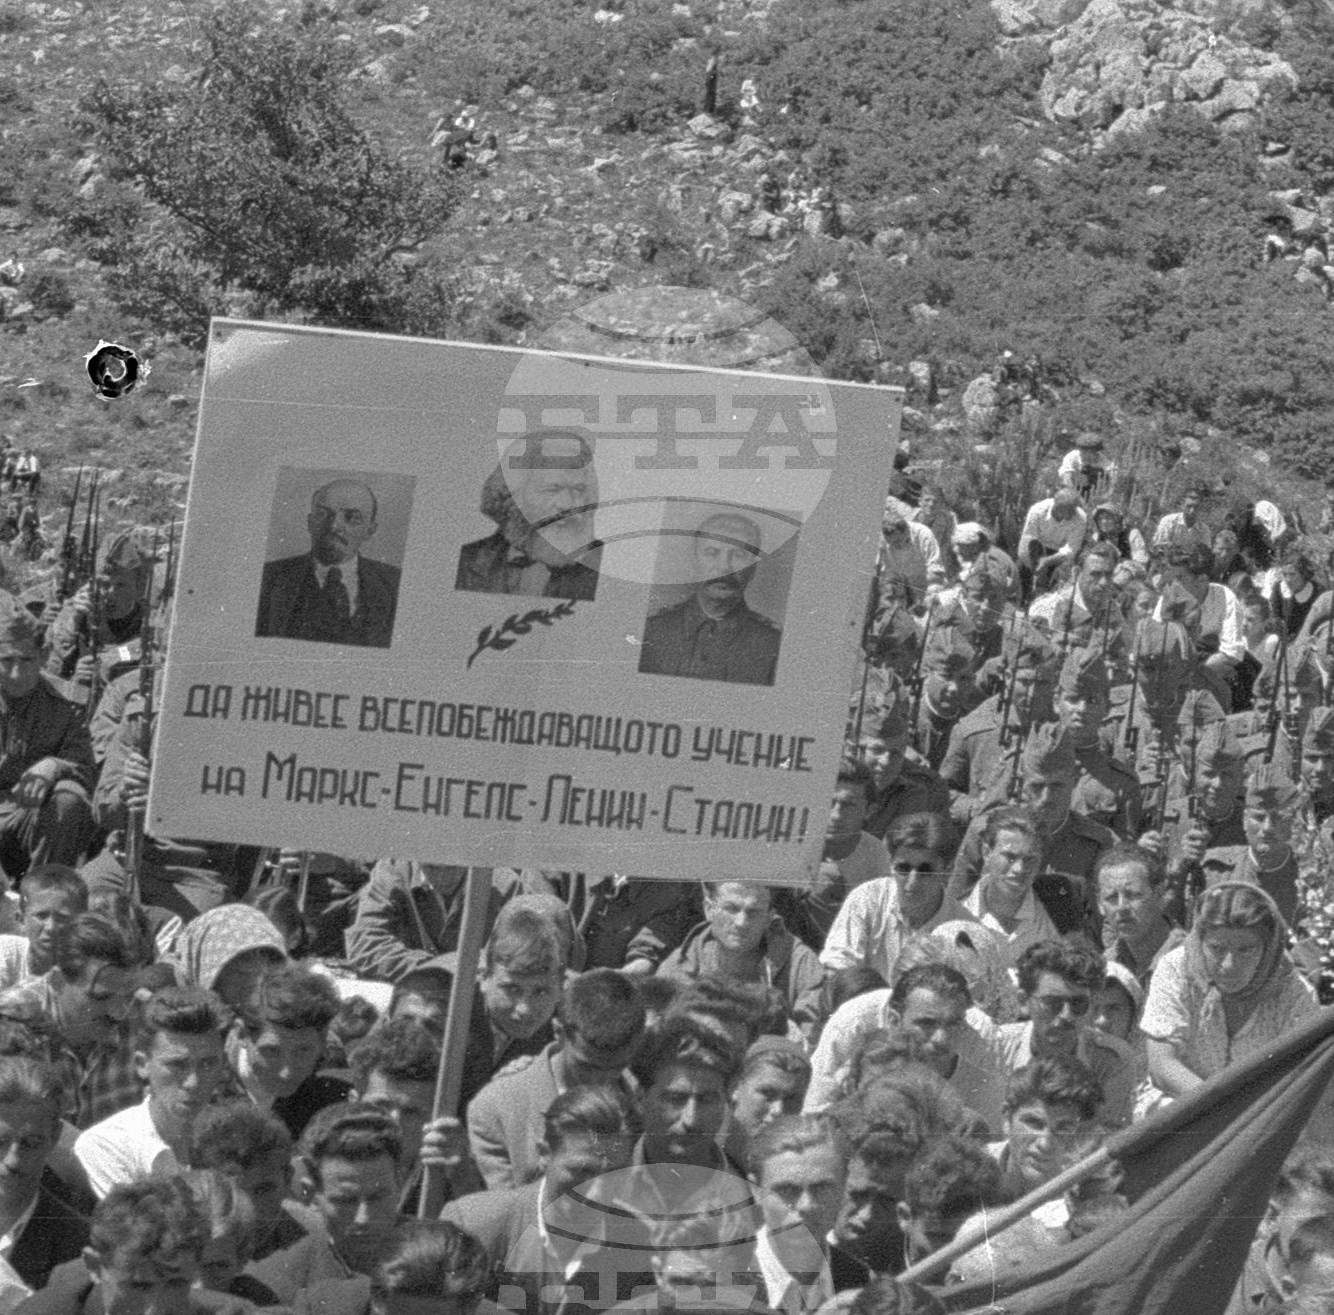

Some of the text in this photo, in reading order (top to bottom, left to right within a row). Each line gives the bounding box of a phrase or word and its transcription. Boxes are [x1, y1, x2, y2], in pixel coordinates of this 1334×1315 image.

[182, 683, 816, 773] ДА ЖИВЕЕ ВСЕПОБЕЖДАВАЩОТО УЧЕНИЕ
